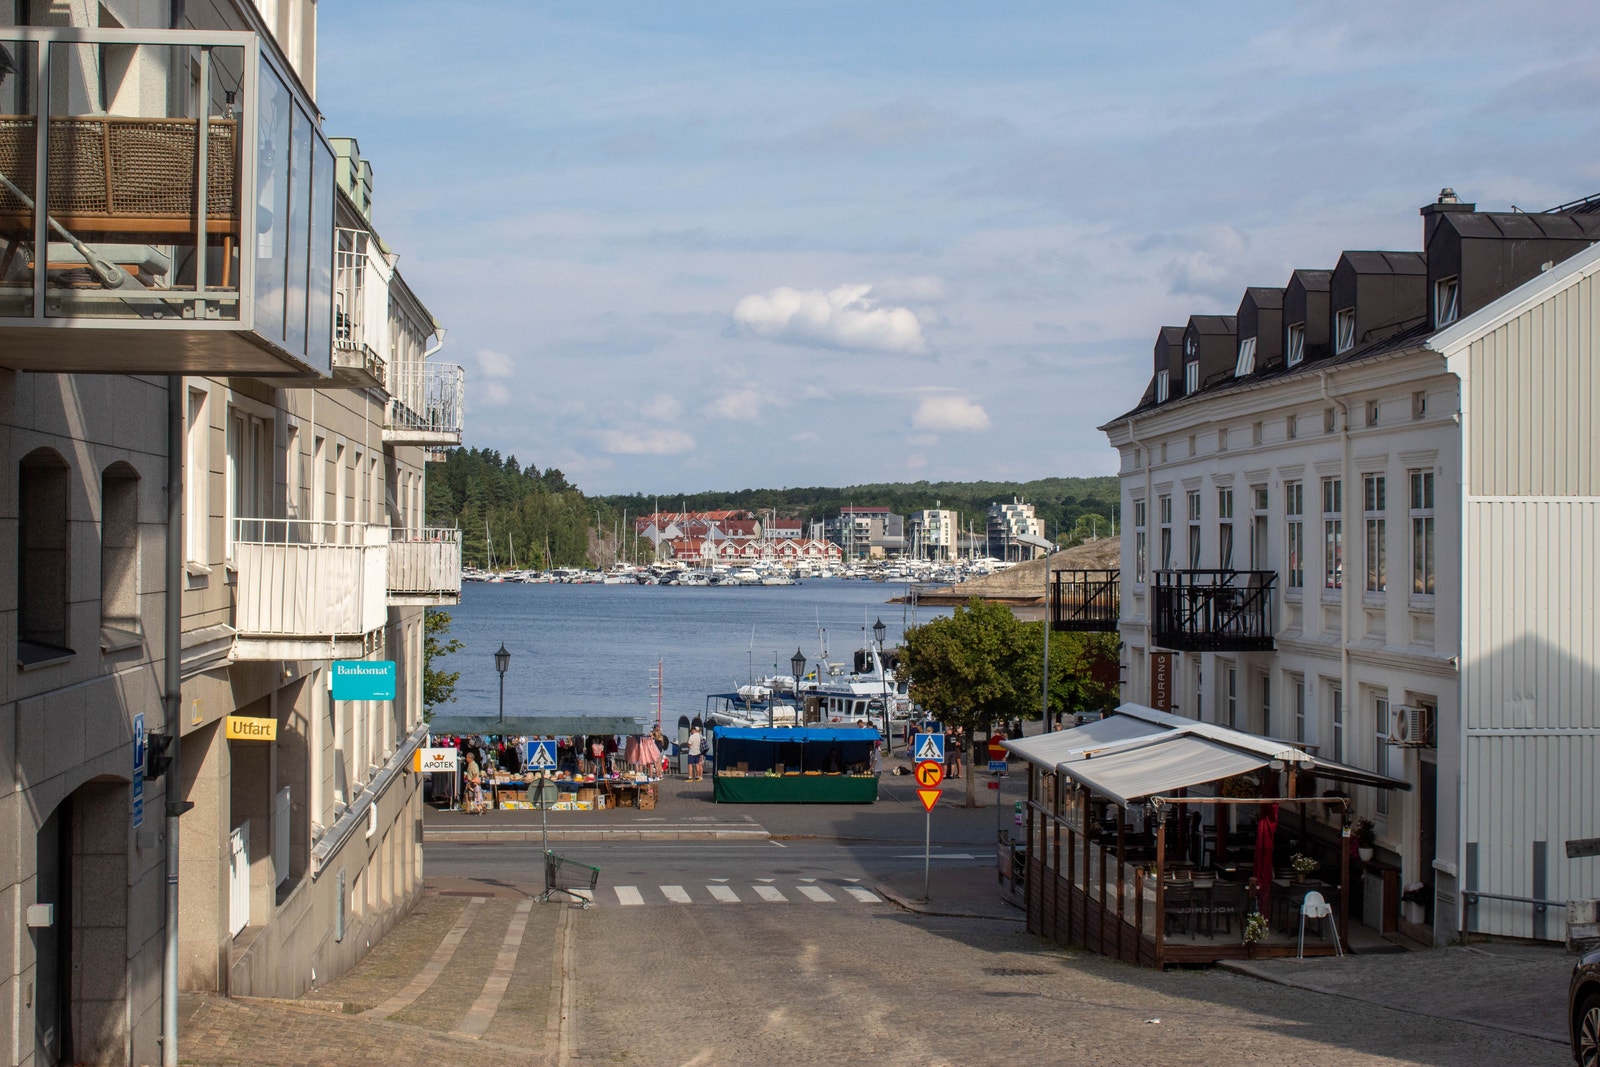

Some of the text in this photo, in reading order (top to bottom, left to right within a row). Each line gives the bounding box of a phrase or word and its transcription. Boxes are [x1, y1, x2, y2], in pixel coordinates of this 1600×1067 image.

[337, 665, 388, 675] Bankomat
[232, 721, 272, 736] Utfart
[136, 720, 142, 763] P
